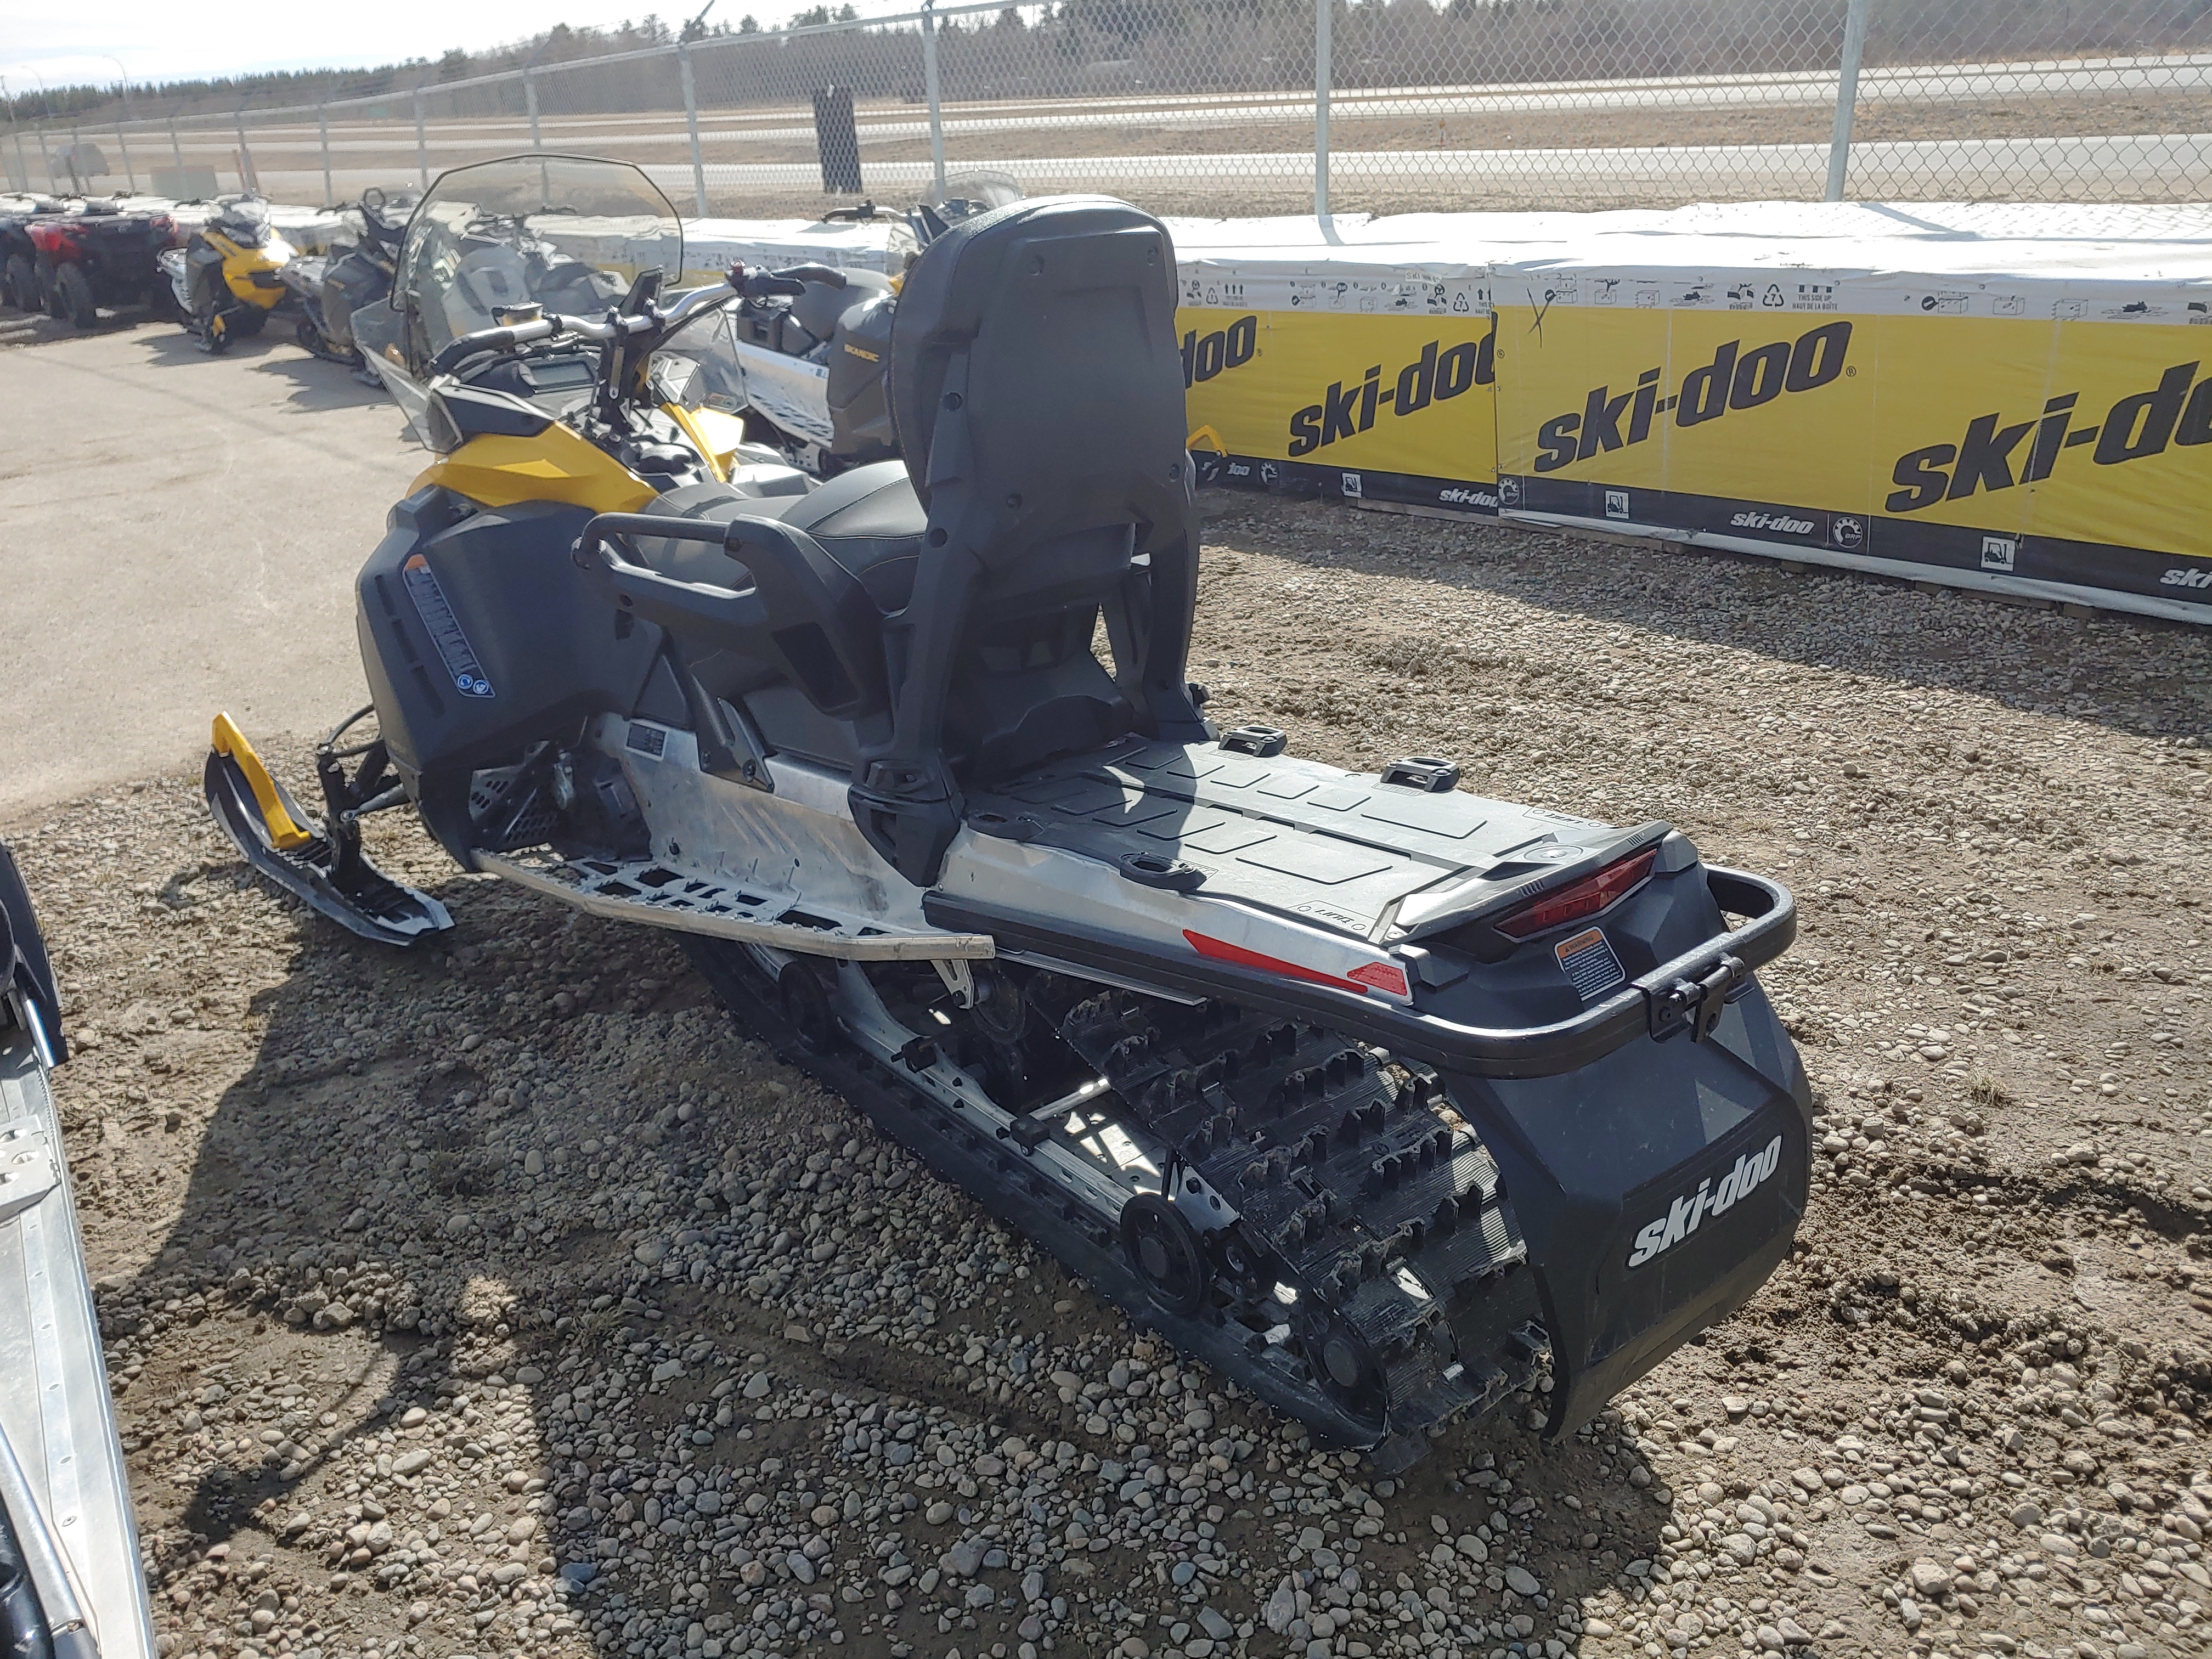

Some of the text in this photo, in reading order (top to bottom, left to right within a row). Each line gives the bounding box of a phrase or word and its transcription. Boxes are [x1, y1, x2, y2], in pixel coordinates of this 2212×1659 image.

[1533, 320, 1853, 472] ski-doo
[1730, 511, 1815, 534] ski-doo
[1628, 1135, 1782, 1267] ski-doo
